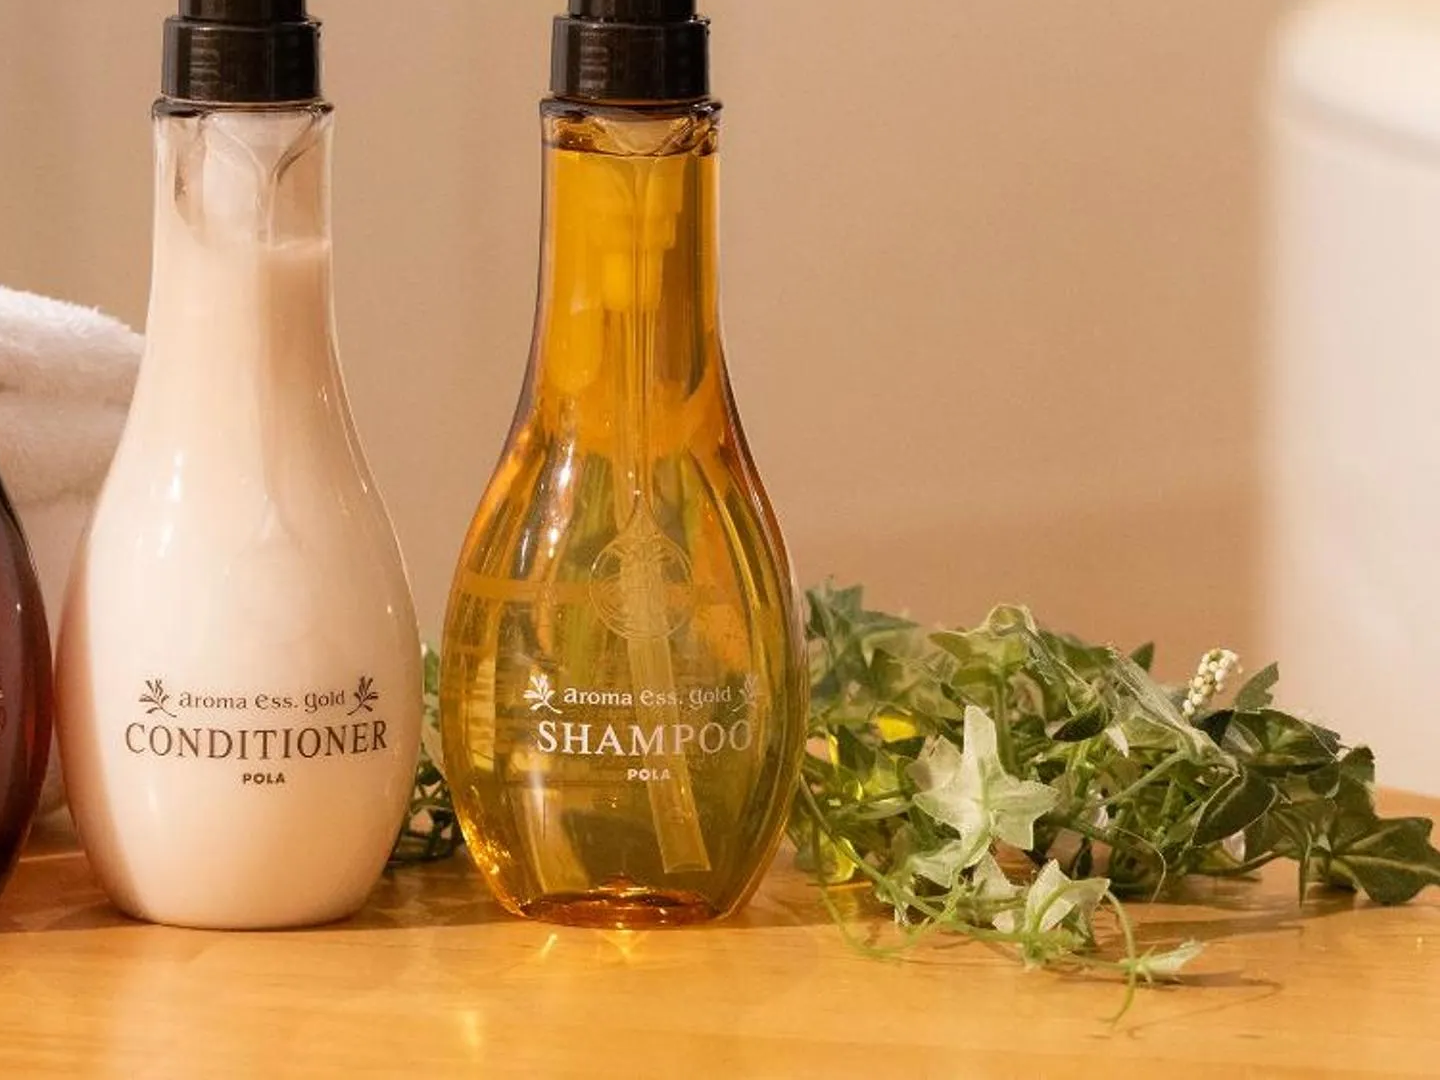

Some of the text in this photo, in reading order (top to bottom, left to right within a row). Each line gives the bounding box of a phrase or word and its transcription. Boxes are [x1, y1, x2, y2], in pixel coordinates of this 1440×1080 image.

[179, 690, 345, 712] aroma ess. gold
[563, 686, 732, 709] aroma ess. gold
[125, 720, 388, 760] CONDITIONER
[537, 720, 753, 756] SHAMPOO
[242, 772, 286, 785] POLA
[627, 768, 671, 781] POLA
